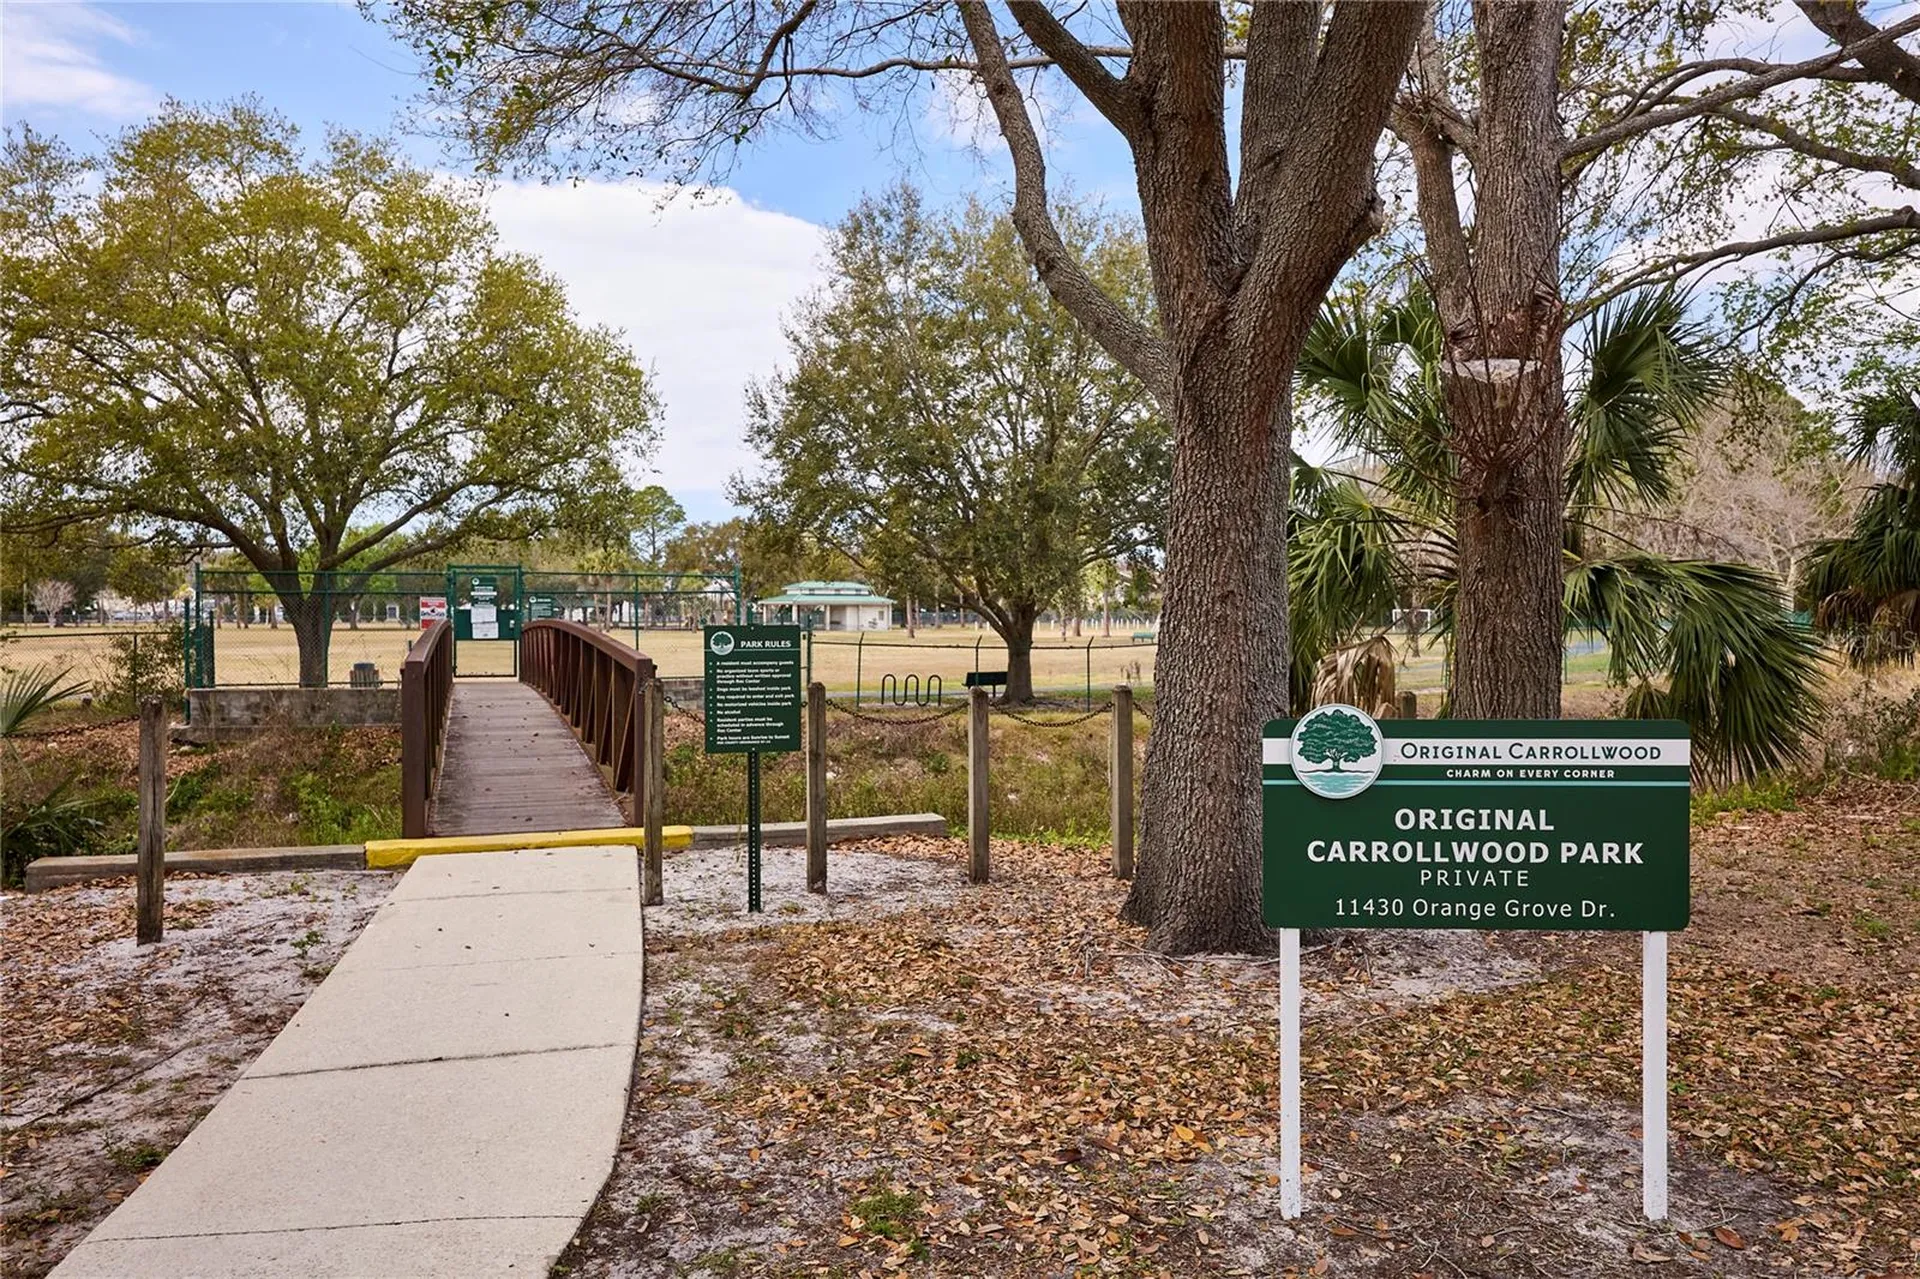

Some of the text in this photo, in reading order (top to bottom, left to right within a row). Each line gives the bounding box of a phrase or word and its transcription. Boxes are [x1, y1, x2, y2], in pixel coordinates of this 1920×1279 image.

[1400, 742, 1661, 760] ORIGINAL CARROLLWOOD
[1446, 769, 1615, 779] CHARM ON EVERY CORNER
[1394, 808, 1554, 831] ORIGINAL
[1307, 841, 1643, 864] CARROLLWOOD PARK
[1421, 870, 1529, 887] PRIVATE
[1336, 898, 1615, 921] 11430 Orange Grove Dr.
